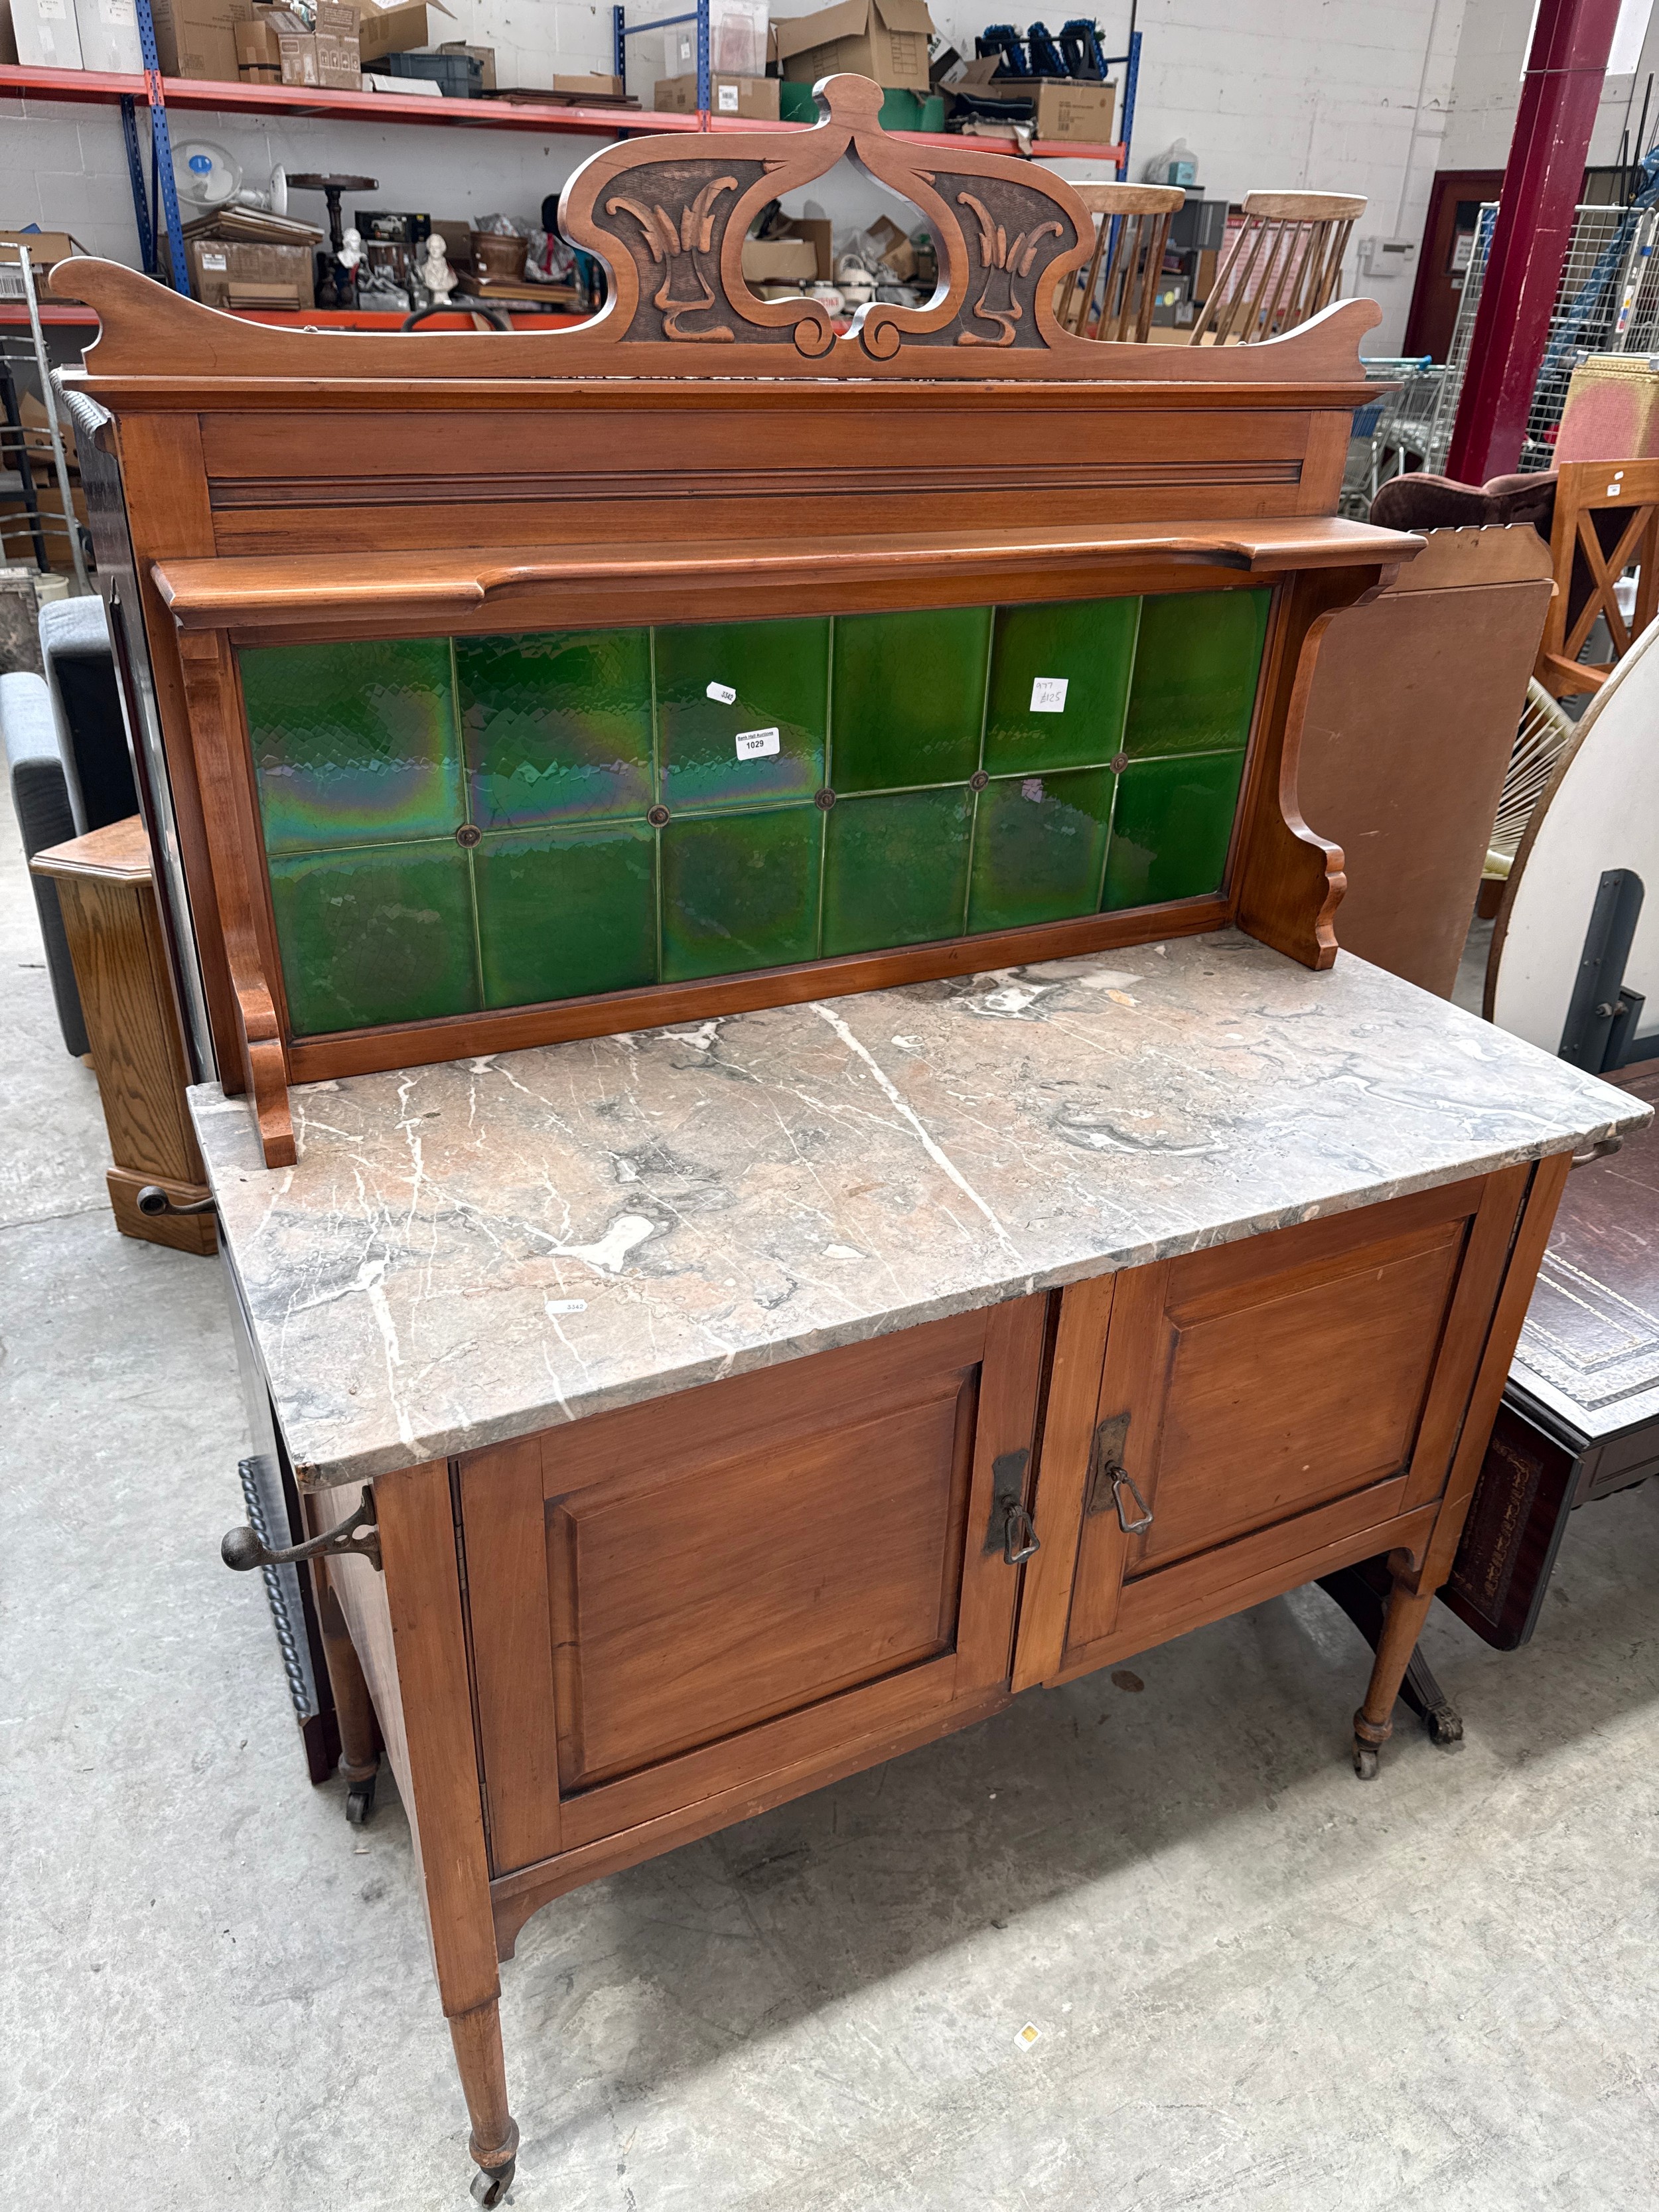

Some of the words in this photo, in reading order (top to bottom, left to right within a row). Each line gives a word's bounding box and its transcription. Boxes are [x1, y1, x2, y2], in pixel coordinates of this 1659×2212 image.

[721, 691, 734, 701] 3342
[1040, 692, 1062, 703] £125
[747, 740, 764, 749] 1029
